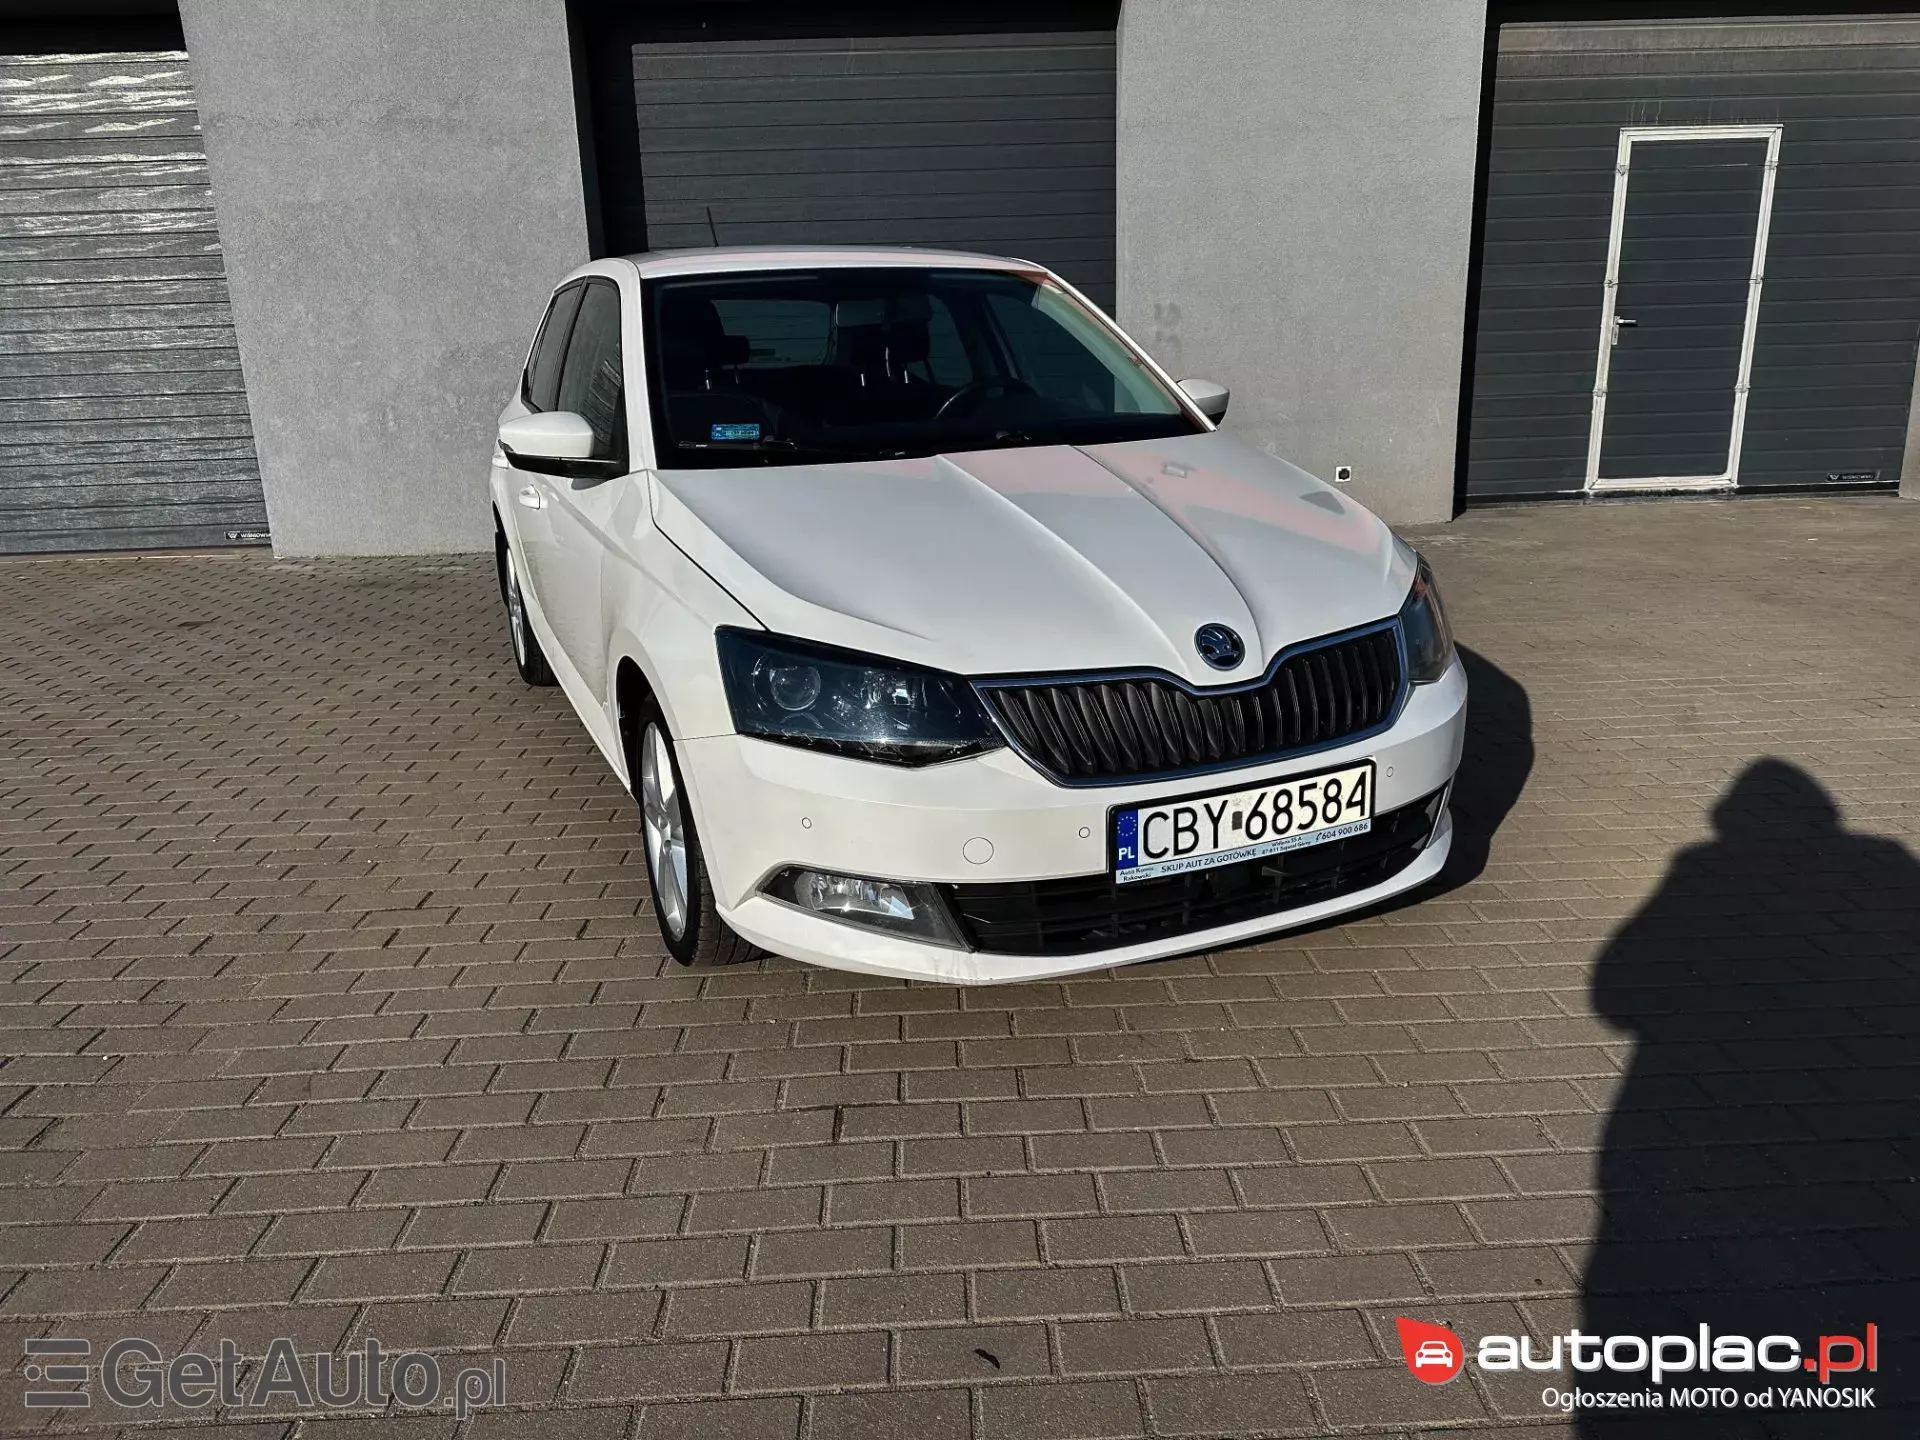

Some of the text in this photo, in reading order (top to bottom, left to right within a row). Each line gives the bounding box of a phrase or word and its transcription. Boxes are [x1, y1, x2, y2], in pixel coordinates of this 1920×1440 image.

[1143, 771, 1367, 859] CBY 68584
[1321, 823, 1368, 840] 604 900 686
[1118, 847, 1135, 860] PL
[1161, 848, 1257, 873] SKUP AUT ZA GOTÓWKĘ
